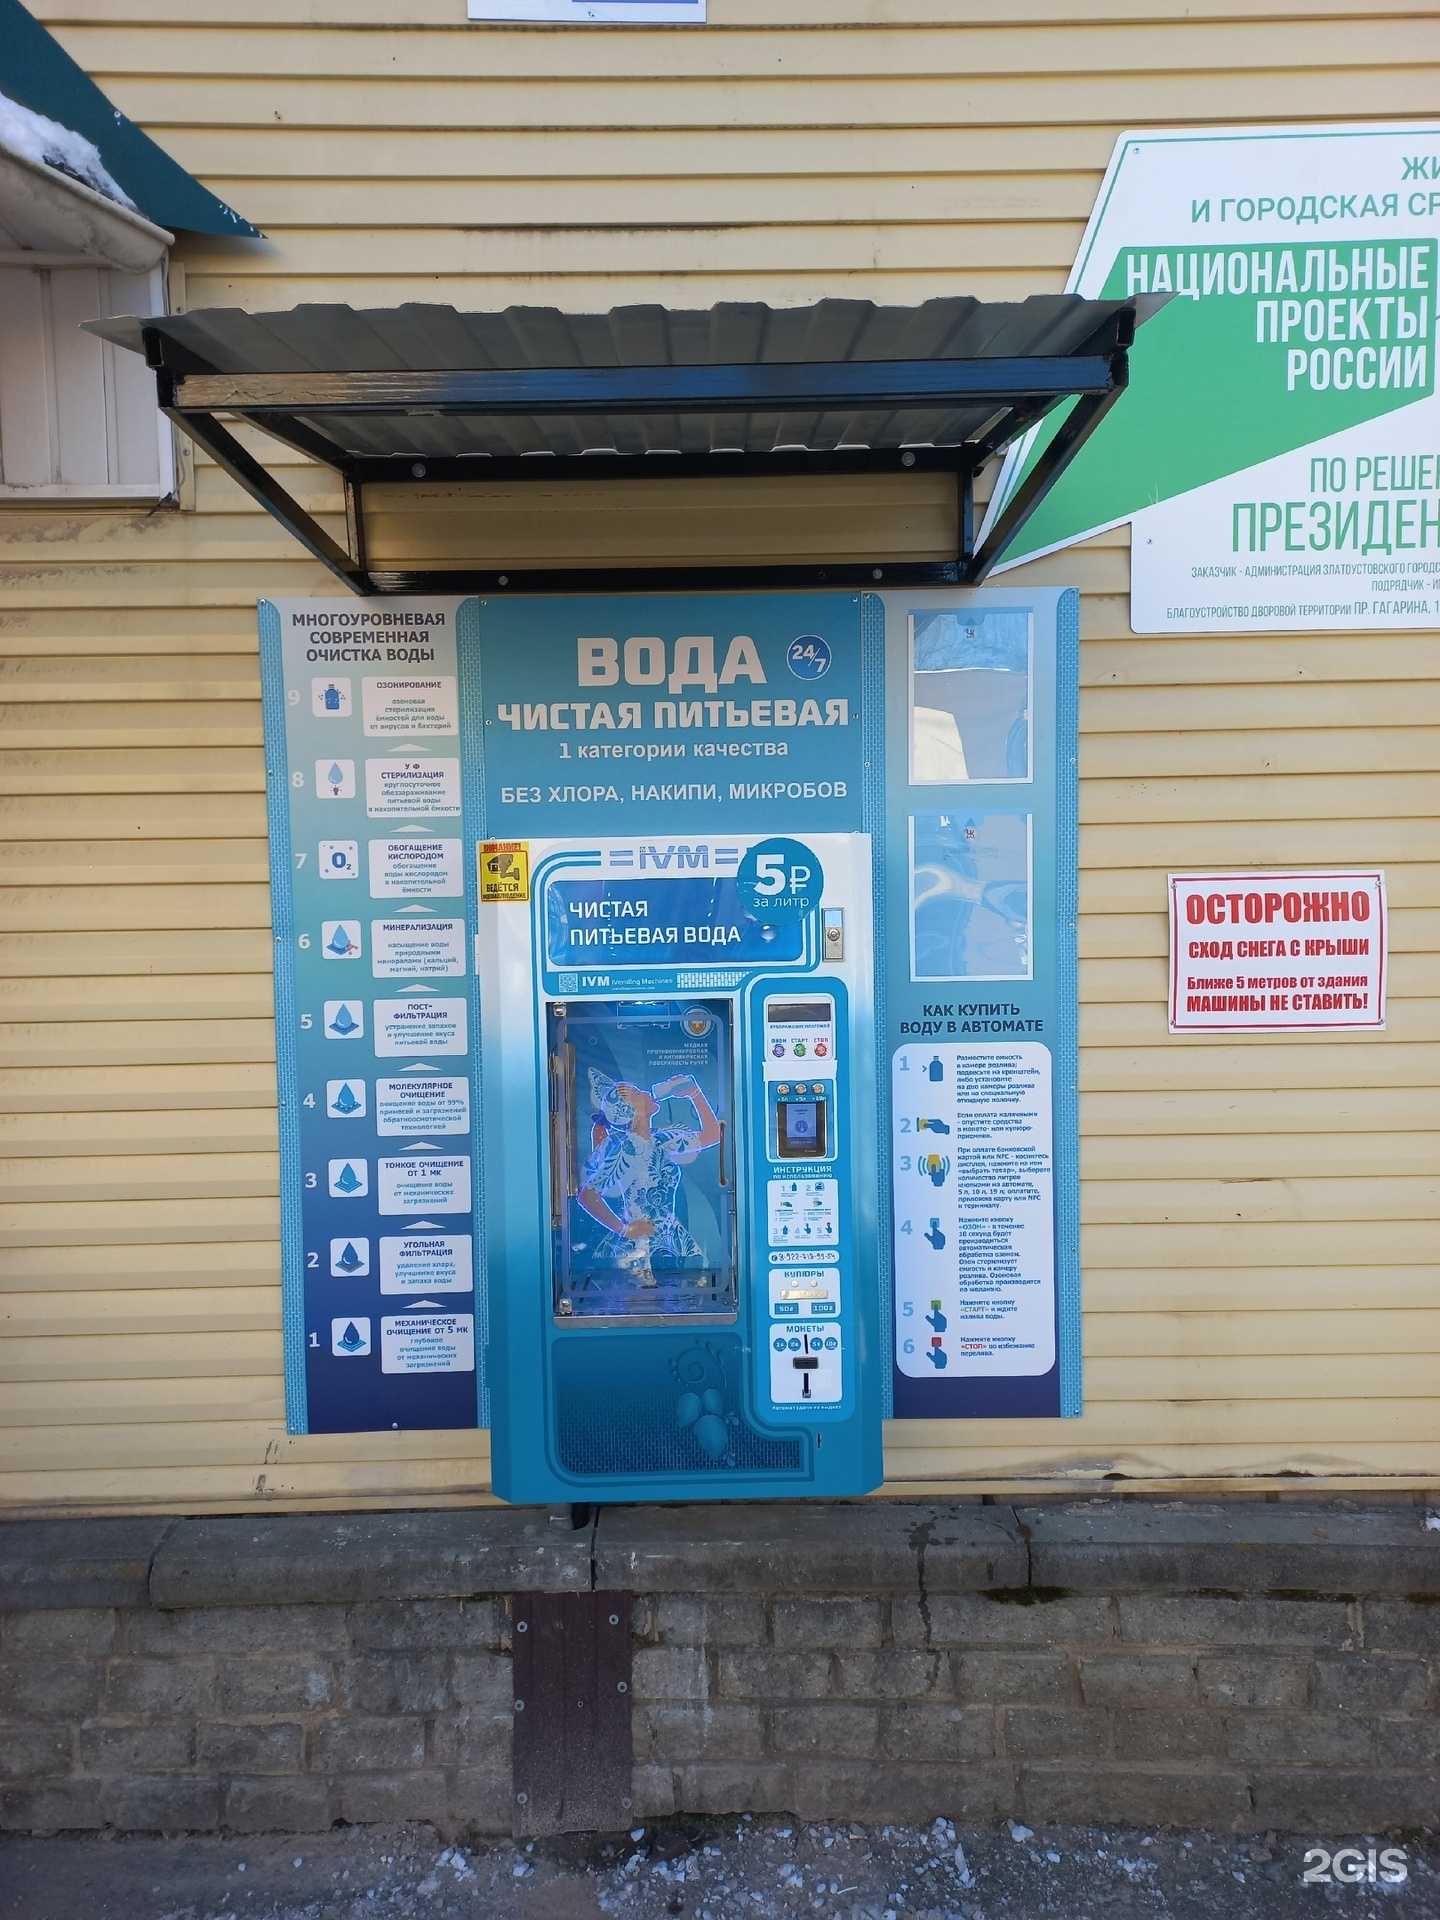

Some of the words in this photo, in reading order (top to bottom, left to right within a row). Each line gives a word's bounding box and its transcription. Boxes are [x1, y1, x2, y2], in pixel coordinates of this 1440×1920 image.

[1191, 199, 1210, 223] И
[1220, 193, 1399, 225] ГОРОДСКАЯ
[1126, 246, 1430, 301] НАЦИОНАЛЬНЫЕ
[1256, 296, 1428, 343] ПРОЕКТЫ
[1287, 345, 1427, 391] РОССИИ
[1310, 457, 1346, 493] ПО
[1355, 454, 1440, 492] РЕШЕ
[1232, 499, 1440, 556] ПРЕЗИДЕН
[1191, 566, 1237, 578] ЗАКАЗЧИК
[1244, 564, 1322, 578] АДМИНИСТРАЦИЯ
[1323, 562, 1406, 576] ЗЛАТОУСТОВСКОГО
[1372, 579, 1424, 592] ПОДРЯДЧИК
[1167, 605, 1249, 619] БЛАГОУСТРОЙСТВО
[1251, 603, 1296, 618] ДВОРОВОЙ
[1298, 603, 1351, 617] ТЕРРИТОРИИ
[1353, 602, 1370, 615] ПР.
[1372, 600, 1430, 615] ГАГАРИНА,
[292, 613, 445, 627] МНОГОУРОВНЕВАЯ
[310, 631, 429, 644] СОВРЕМЕННАЯ
[306, 649, 381, 662] ОЧИСТКА
[387, 648, 434, 663] ВОДЫ
[577, 636, 767, 694] ВОДА
[376, 681, 442, 689] ОЗОНИРОВАНИЕ
[288, 690, 300, 706] 9
[497, 702, 642, 730] ЧИСТАЯ
[654, 699, 849, 729] ПИТЬЕВАЯ
[560, 743, 571, 758] 1
[578, 743, 686, 761] категории
[694, 742, 788, 757] качества
[292, 772, 304, 788] 8
[381, 772, 444, 780] СТЕРИЛИЗАЦИЯ
[501, 787, 541, 803] БЕЗ
[548, 786, 624, 805] ХЛОРА,
[631, 784, 722, 803] НАКИПИ,
[729, 782, 847, 800] МИКРОБОВ
[388, 844, 443, 852] ОБОГАЩЕНИЕ
[295, 853, 308, 870] 7
[569, 901, 648, 918] ЧИСТАЯ
[753, 898, 769, 907] за
[773, 897, 810, 908] литр
[1186, 891, 1370, 925] ОСТОРОЖНО
[298, 933, 311, 949] 6
[570, 927, 678, 947] ПИТЬЕВАЯ
[684, 925, 741, 945] ВОДА
[1189, 941, 1233, 960] СХОД
[1237, 940, 1287, 957] СНЕГА
[1290, 940, 1300, 956] С
[1305, 938, 1369, 956] КРЫШИ
[582, 976, 610, 987] IVM
[1187, 977, 1233, 990] Ближе
[1236, 976, 1244, 989] 5
[1248, 977, 1297, 990] метров
[1300, 977, 1314, 988] от
[1318, 976, 1368, 989] здания
[923, 1004, 954, 1017] КАК
[958, 1003, 1020, 1016] КУПИТЬ
[1187, 995, 1265, 1012] МАШИНЫ
[1270, 994, 1288, 1011] НЕ
[1292, 993, 1368, 1010] СТАВИТЬ!
[300, 1013, 313, 1030] 5
[393, 1012, 448, 1020] ФИЛЬТРАЦИЯ
[900, 1021, 943, 1036] ВОДУ
[947, 1021, 957, 1033] В
[961, 1019, 1044, 1033] АВТОМАТЕ
[899, 1056, 910, 1071] 1
[389, 1082, 453, 1090] МОЛЕКУЛЯРНОЕ
[303, 1093, 316, 1108] 4
[400, 1091, 446, 1099] ОЧИЩЕНИЕ
[900, 1118, 912, 1133] 2
[900, 1156, 912, 1171] 3
[305, 1173, 318, 1188] 3
[900, 1219, 913, 1235] 4
[307, 1252, 319, 1268] 2
[400, 1249, 453, 1257] ФИЛЬТРАЦИЯ
[902, 1301, 914, 1317] 5
[395, 1319, 456, 1327] МЕХАНИЧЕСКОЕ
[309, 1332, 320, 1348] 1
[387, 1328, 431, 1336] ОЧИЩЕНИЕ
[903, 1338, 915, 1354] 6
